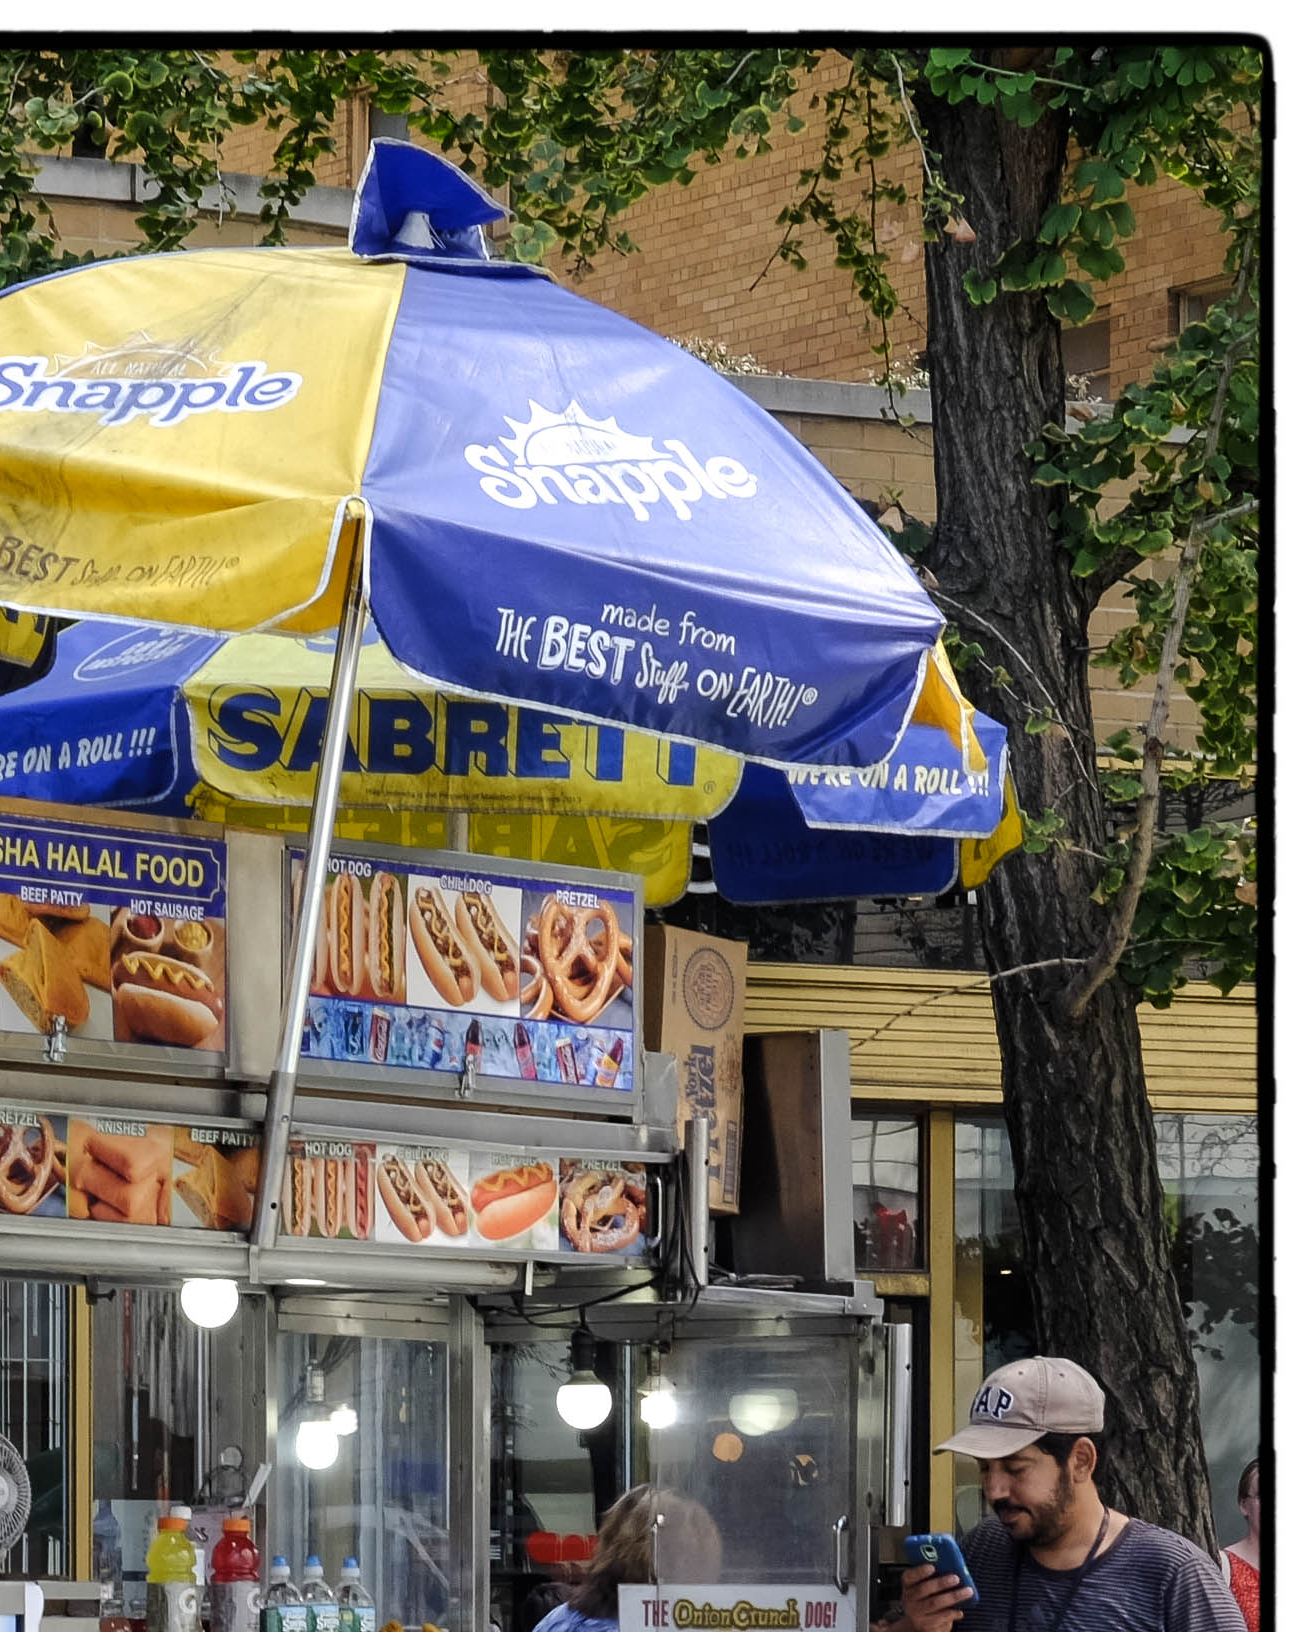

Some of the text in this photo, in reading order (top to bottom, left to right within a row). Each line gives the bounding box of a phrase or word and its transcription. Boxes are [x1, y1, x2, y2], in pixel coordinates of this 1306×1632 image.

[464, 440, 757, 520] Snapple
[601, 602, 736, 656] made from
[496, 607, 536, 662] THE
[537, 615, 637, 685] BEST
[635, 642, 690, 703] Stuff
[696, 668, 734, 701] ON
[22, 744, 51, 775] ON
[58, 742, 72, 770] A
[77, 732, 123, 766] ROLL
[129, 727, 156, 757] !!!
[787, 765, 851, 788] WE'RE
[858, 760, 890, 789] ON
[895, 763, 908, 791] A
[913, 764, 962, 797] ROLL
[47, 842, 129, 880] HALAL
[135, 853, 205, 889] FOOD
[348, 860, 373, 878] DOG
[440, 874, 493, 895] CHILI DOG
[20, 885, 84, 907] BEEF PATTY
[555, 889, 600, 909] PRETZEL
[130, 899, 205, 921] HOT SAUSAGE
[95, 1118, 146, 1137] KNISHES
[191, 1128, 220, 1144] BEEF
[305, 1140, 353, 1157] HOT DOG
[581, 1158, 622, 1173] PRETZEL
[970, 1384, 1014, 1420] AP
[643, 1600, 669, 1627] THE
[804, 1601, 838, 1628] DOG!
